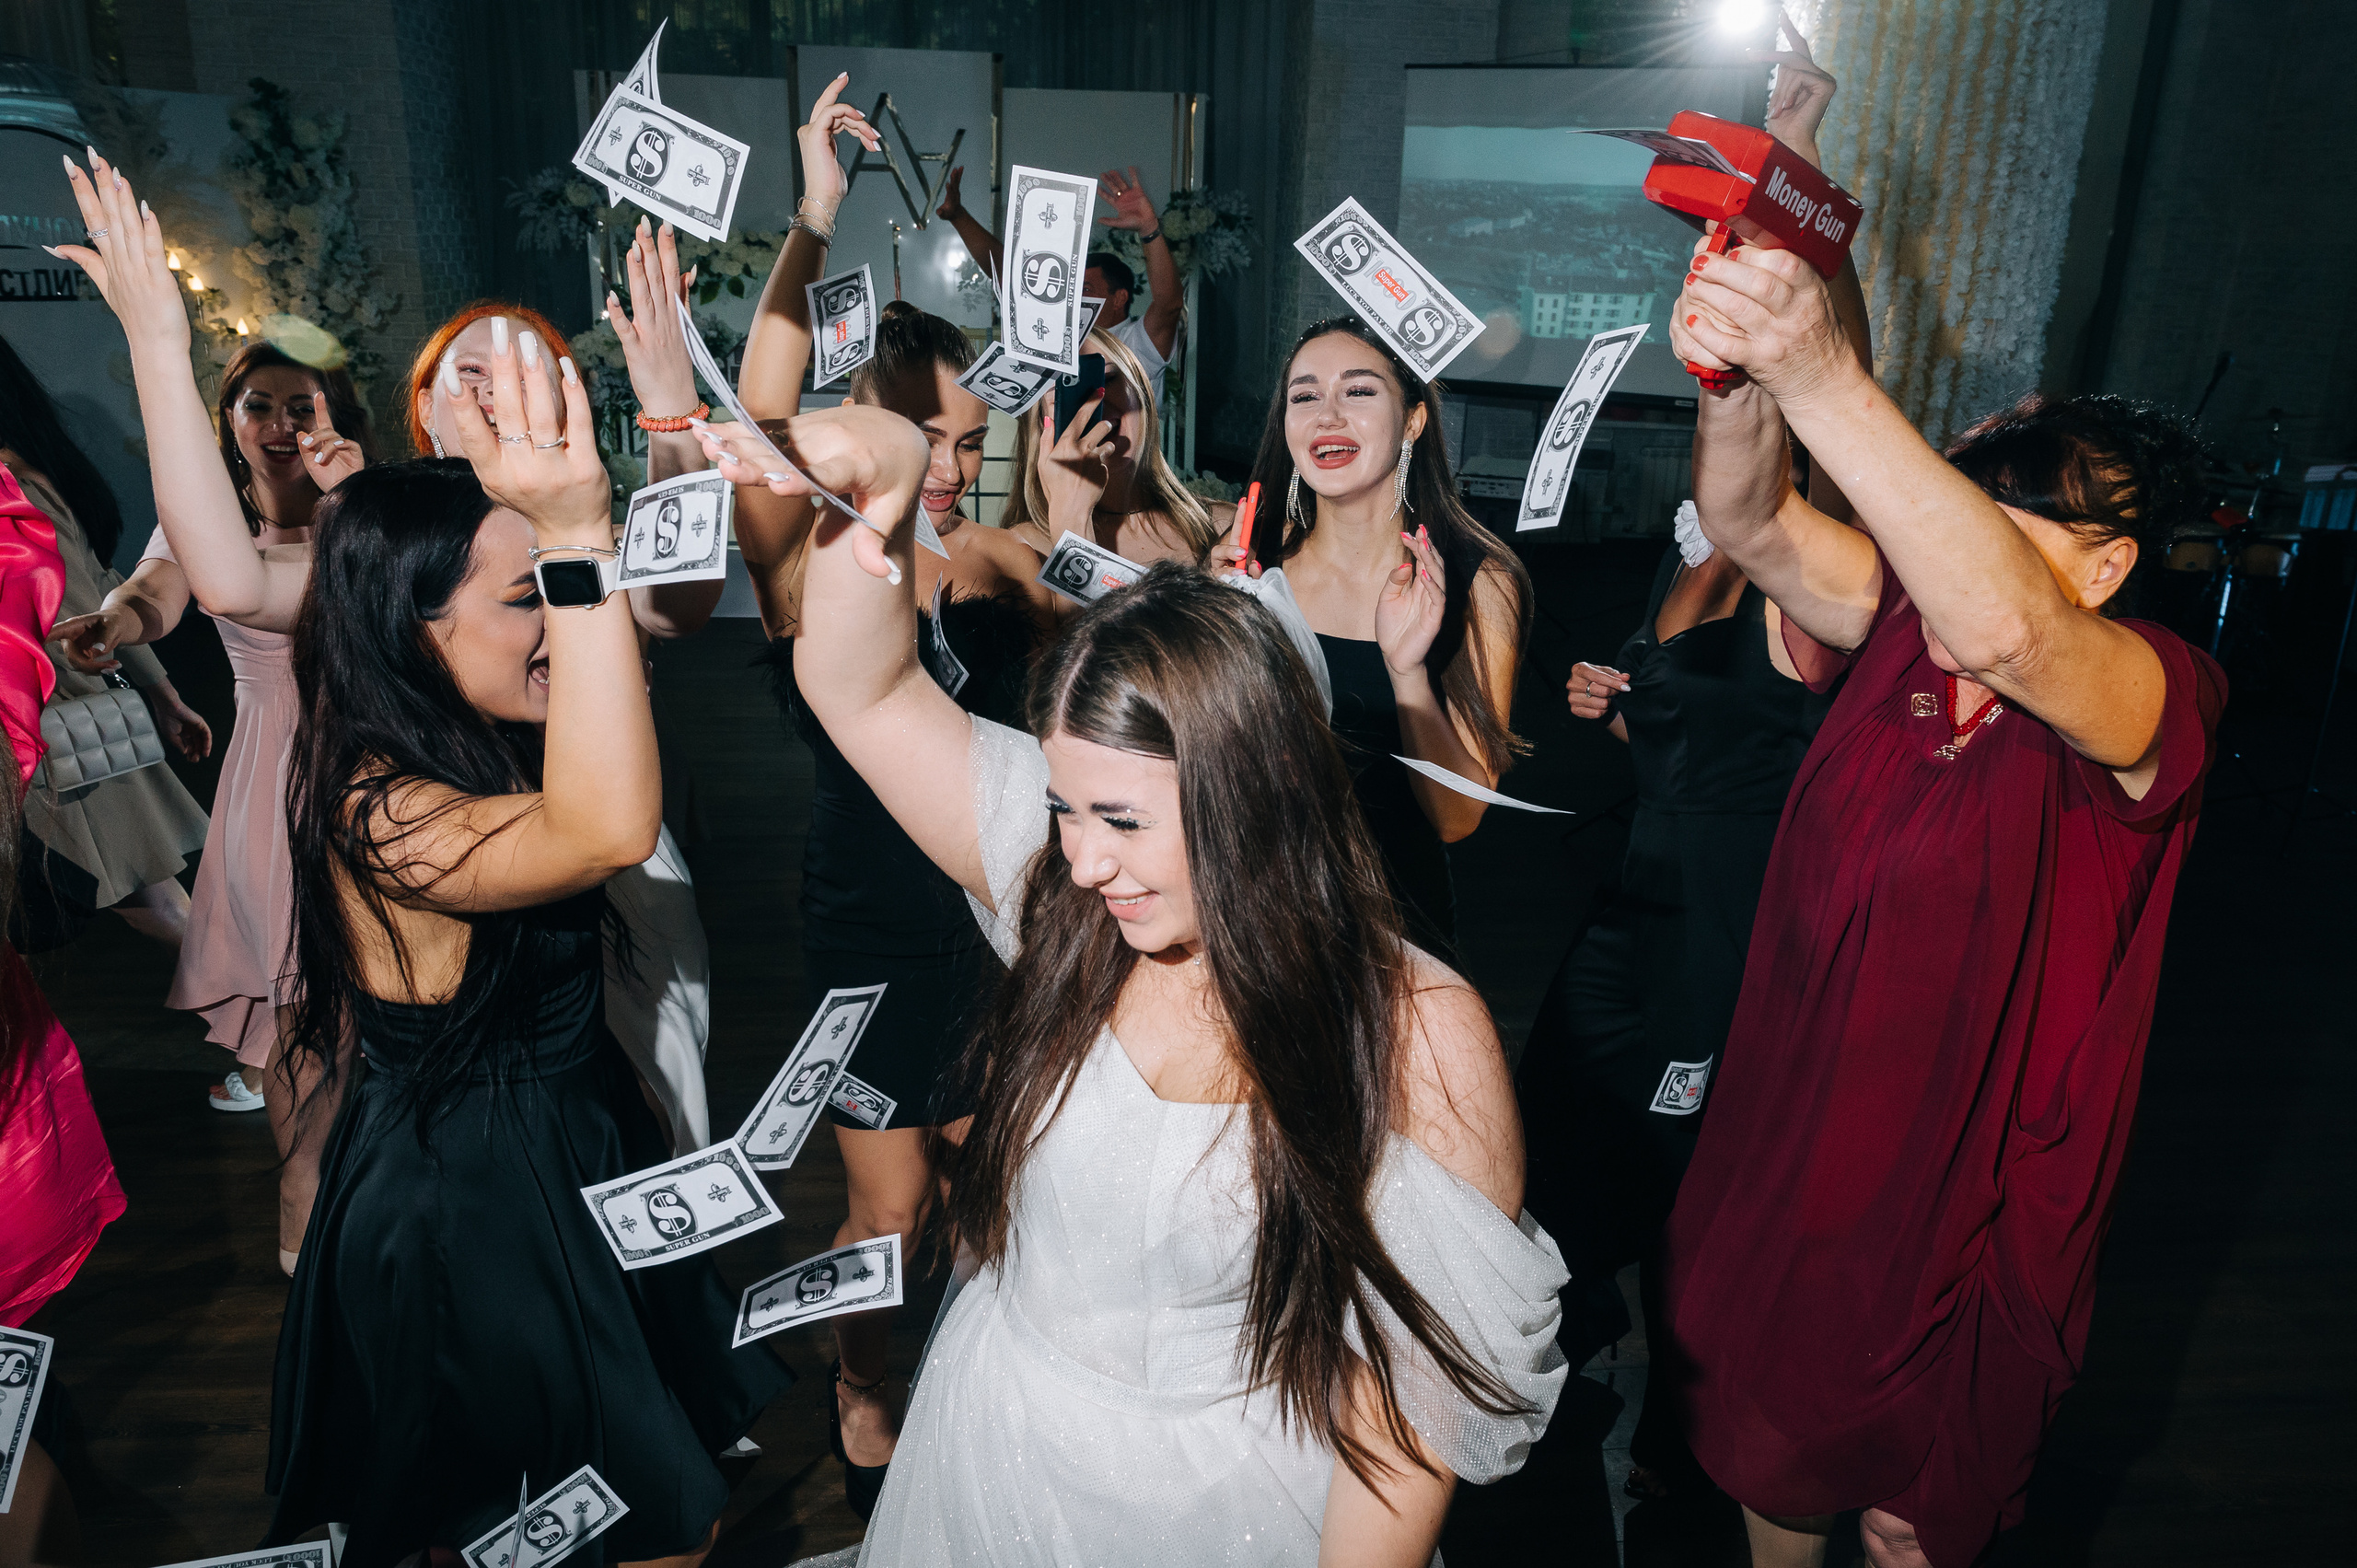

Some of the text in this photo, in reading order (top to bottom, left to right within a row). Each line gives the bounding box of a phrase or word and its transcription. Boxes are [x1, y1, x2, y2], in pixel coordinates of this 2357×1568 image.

[619, 175, 662, 201] SUPER GUN
[1764, 165, 1846, 243] Money Gun
[1378, 271, 1407, 299] Super Gun
[1341, 281, 1394, 335] LUCK YOU PAY ME
[665, 1232, 711, 1252] SUPER GUN
[9, 1386, 33, 1453] LUCK YOU PAY ME
[250, 1557, 273, 1566] LUCK
